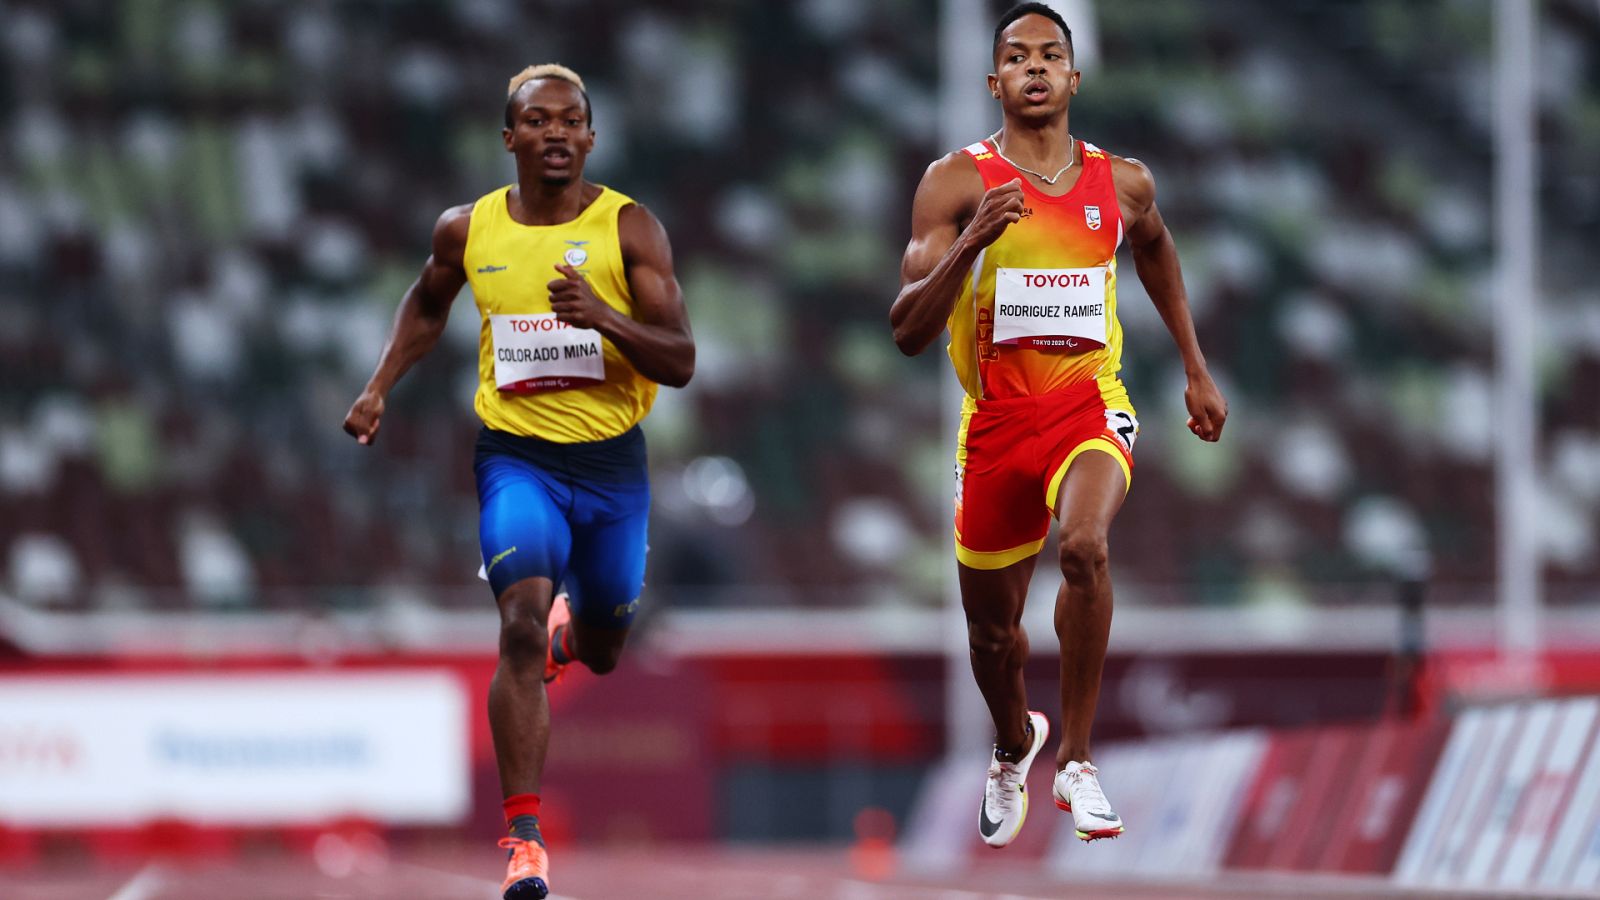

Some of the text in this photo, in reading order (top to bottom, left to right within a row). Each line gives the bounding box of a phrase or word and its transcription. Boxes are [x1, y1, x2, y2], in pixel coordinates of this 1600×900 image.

[1023, 273, 1090, 288] TOYOTA
[999, 303, 1103, 318] RODRIGUEZ RAMIREZ
[978, 306, 999, 362] ESP
[498, 342, 598, 363] COLORADO MINA
[1115, 411, 1135, 450] 2
